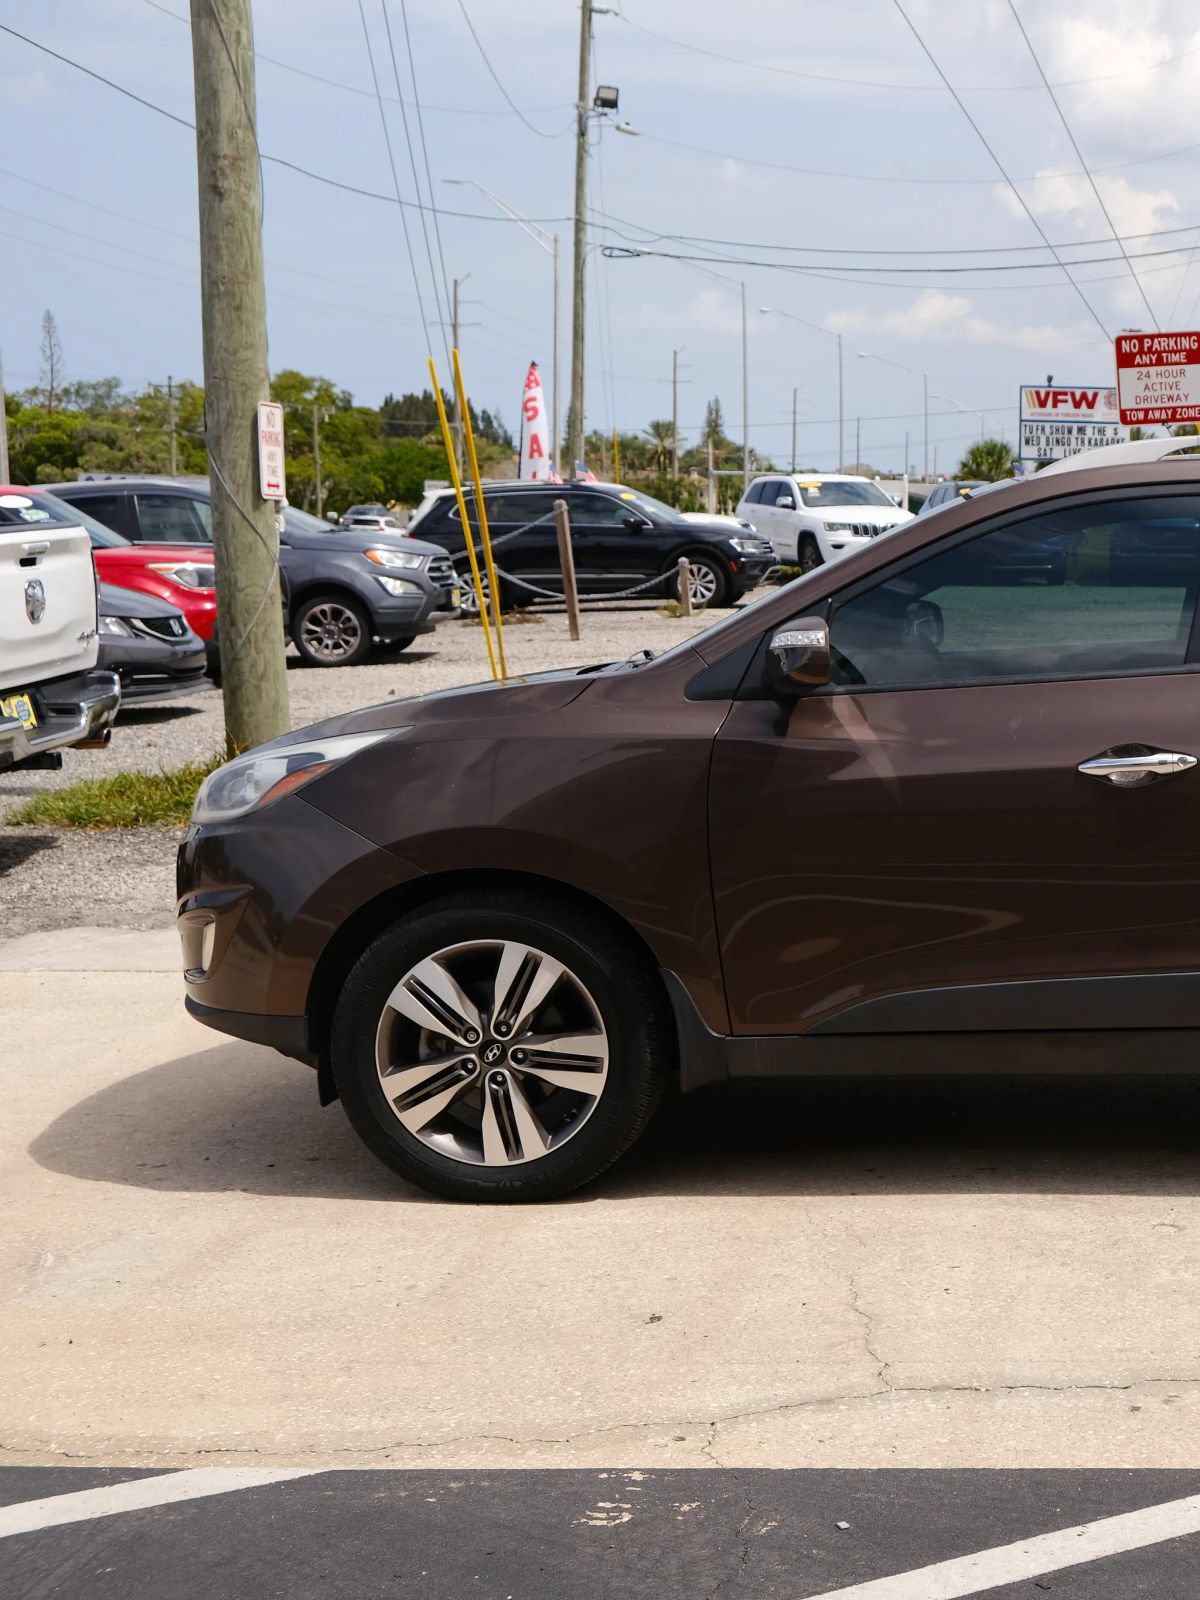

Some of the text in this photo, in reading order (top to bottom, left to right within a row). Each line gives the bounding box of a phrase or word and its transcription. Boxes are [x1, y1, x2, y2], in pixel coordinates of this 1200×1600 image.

[1121, 336, 1199, 353] NO PARKING
[1134, 352, 1188, 365] ANY TIME
[1136, 368, 1186, 381] 24 HOUR
[1143, 381, 1181, 392] ACTIVE
[1034, 389, 1099, 410] VFW
[1135, 393, 1190, 405] DRIVEWAY
[266, 410, 275, 428] NO
[1125, 410, 1145, 421] TOW
[1147, 409, 1173, 420] AWAY
[1175, 407, 1200, 418] ZONE
[1049, 424, 1074, 436] SHOW
[1077, 425, 1087, 436] ME
[1092, 426, 1107, 437] THE
[261, 430, 281, 447] PARKING
[1024, 436, 1041, 446] WED
[1046, 436, 1072, 447] BINGO
[1037, 447, 1054, 458] SAT
